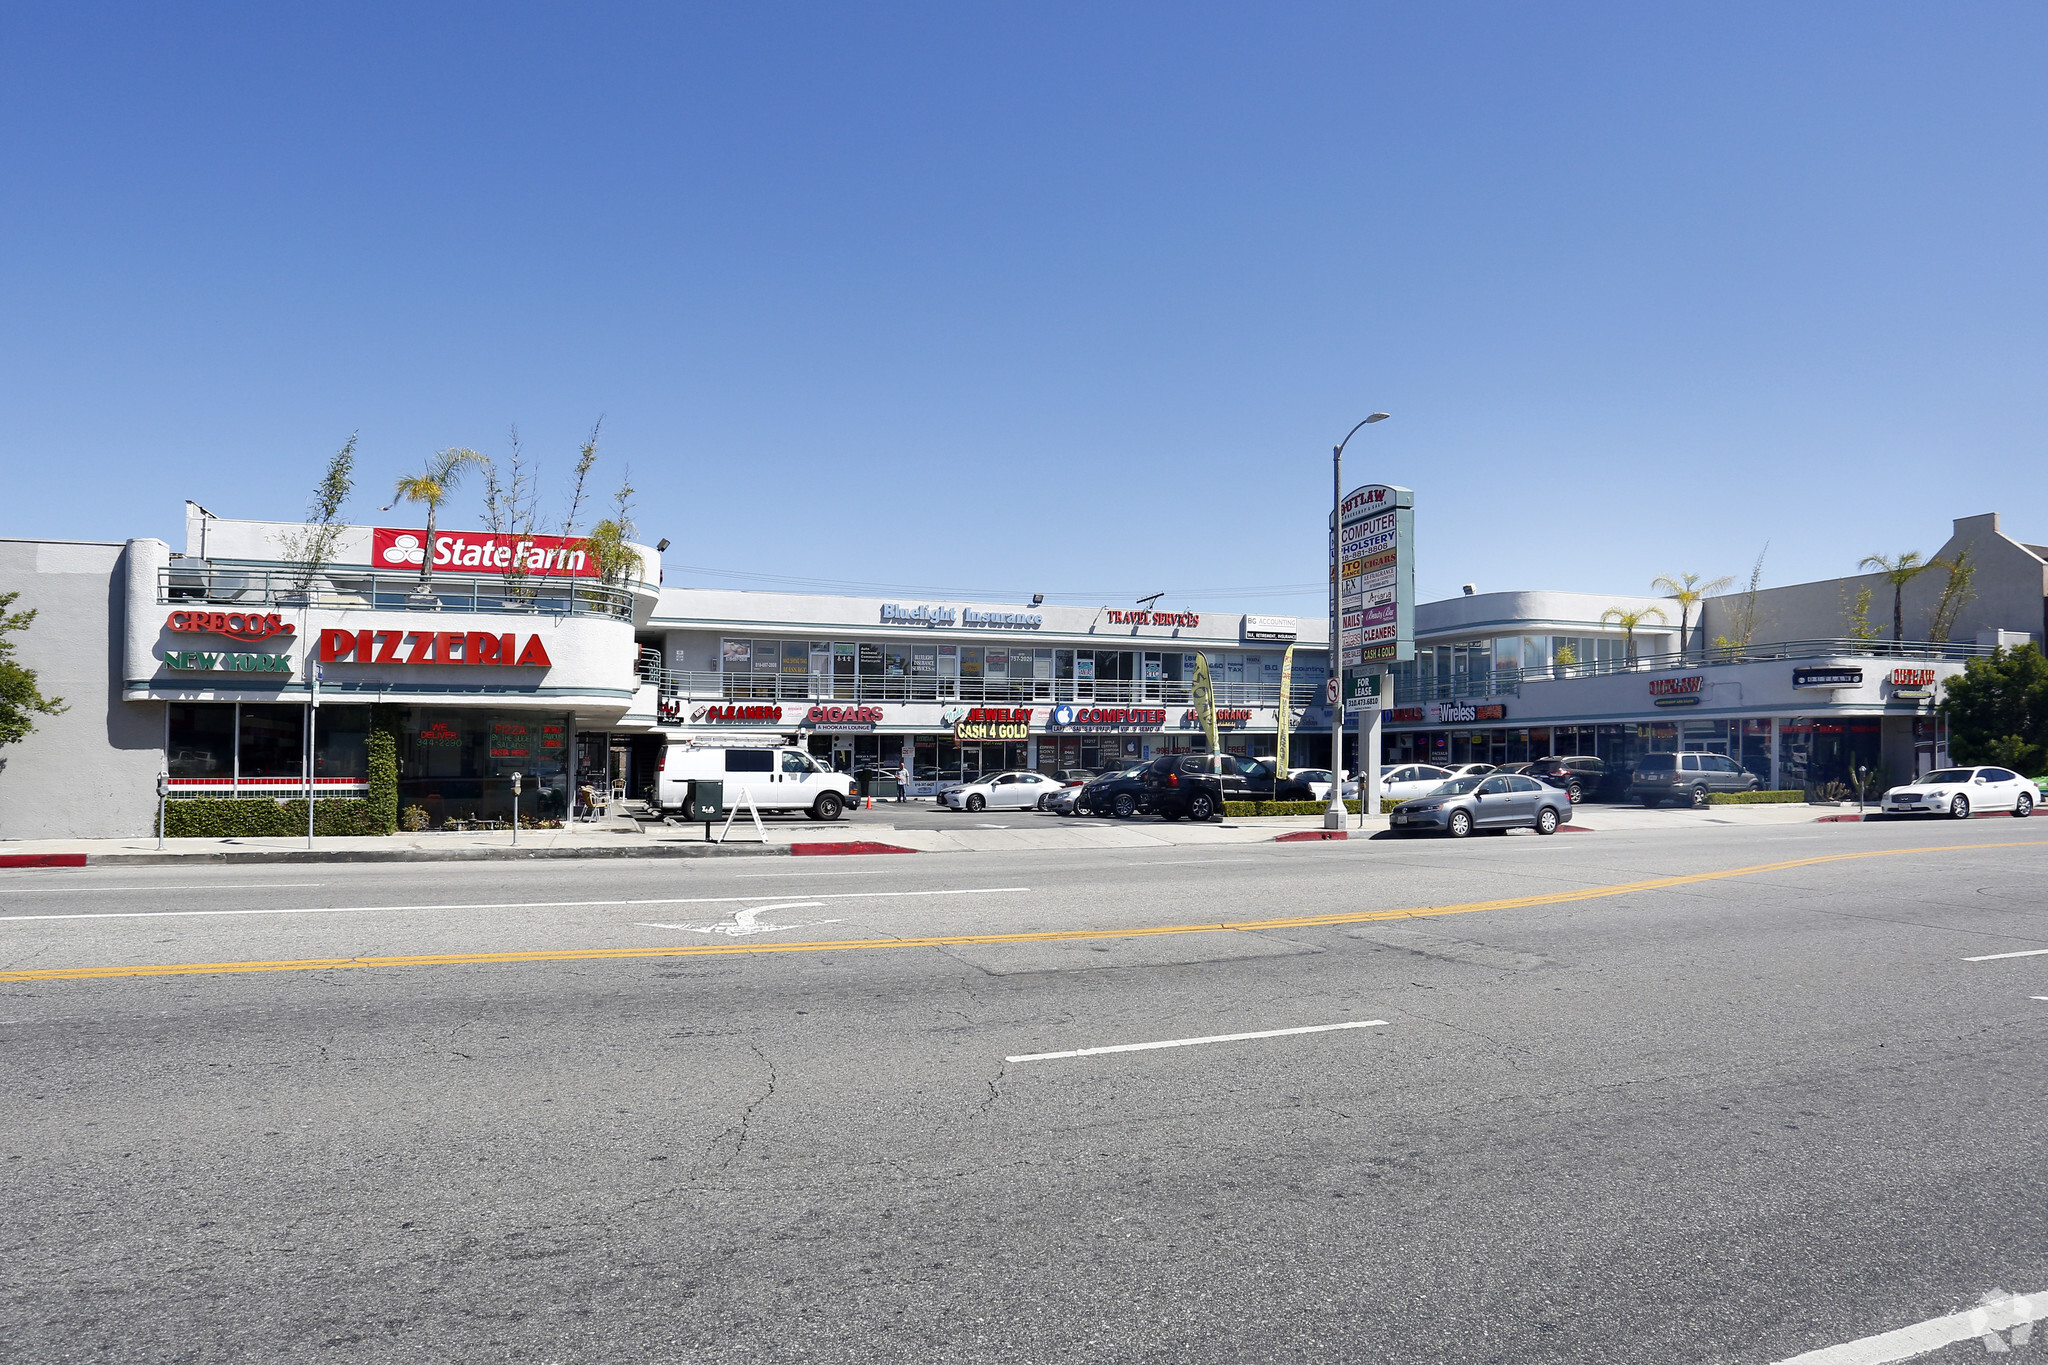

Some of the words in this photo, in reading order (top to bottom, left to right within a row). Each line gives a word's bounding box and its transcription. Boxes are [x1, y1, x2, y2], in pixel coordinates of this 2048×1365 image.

[1342, 513, 1395, 543] COMPUTER
[1341, 542, 1388, 562] 18-881-8808
[1363, 553, 1397, 569] CIGARS
[883, 603, 957, 624] Bluelight
[964, 606, 1044, 626] Insurance
[1107, 610, 1151, 625] TRAVEL
[1152, 612, 1200, 627] SERVICES
[1247, 617, 1257, 625] BG
[1258, 618, 1296, 626] ACCOUNTING
[1342, 613, 1361, 630] NAILS
[166, 610, 296, 643] GRECO'S
[1363, 624, 1396, 642] CLEANERS
[320, 628, 552, 667] PIZZERIA
[1363, 648, 1377, 661] CASH
[1377, 648, 1381, 657] 4
[1381, 645, 1395, 657] GOLD
[163, 650, 220, 672] NEW
[226, 652, 293, 673] YORK
[1289, 665, 1325, 674] ccounting
[1893, 668, 1936, 686] OUTLAW
[1357, 677, 1370, 687] FOR
[1648, 676, 1703, 695] OUTLAW
[1354, 686, 1372, 697] LEASE
[1348, 697, 1379, 708] 310.473.6810
[708, 705, 783, 720] CLEANERS
[807, 706, 883, 722] CIGARS
[967, 708, 1034, 721] JEWELRY
[1078, 708, 1167, 723] COMPUTER
[1187, 709, 1198, 720] LE
[1216, 708, 1253, 720] GRANCE
[1392, 706, 1423, 721] NAILS
[1440, 701, 1476, 722] Wireless
[432, 722, 449, 731] WE
[494, 723, 527, 736] PIZZA
[957, 723, 988, 739] CASH
[989, 724, 997, 739] 4
[998, 724, 1028, 739] GOLD
[420, 731, 458, 740] DELIVER
[416, 739, 463, 748] 344-2290
[1227, 745, 1246, 754] FREE
[491, 748, 510, 757] PASTA
